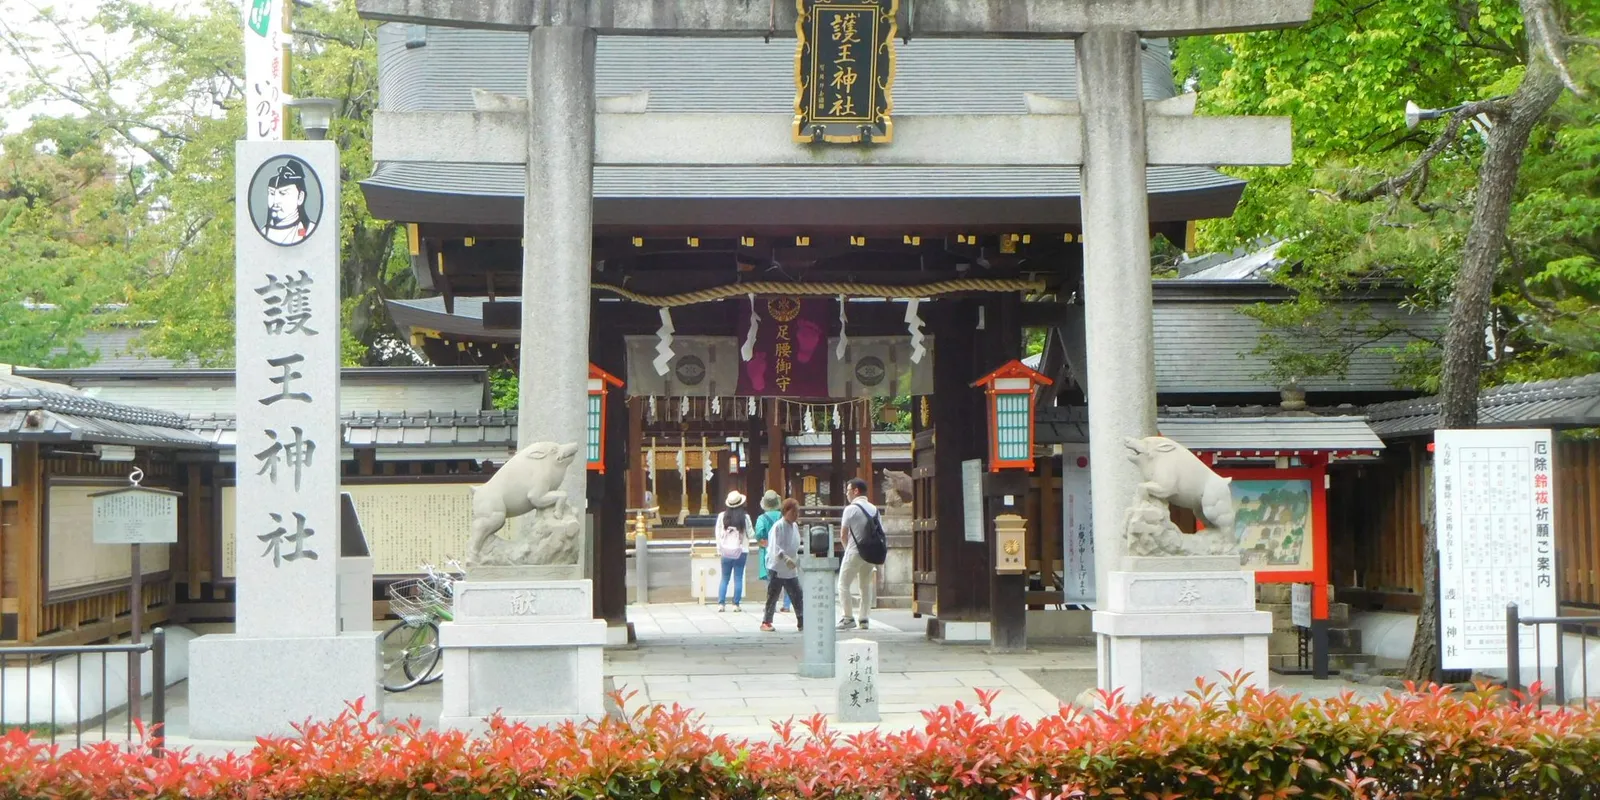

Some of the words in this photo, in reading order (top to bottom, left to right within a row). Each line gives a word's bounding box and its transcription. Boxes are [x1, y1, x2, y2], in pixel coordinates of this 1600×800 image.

[828, 12, 861, 116] 護王神社
[775, 324, 792, 392] 足腰御守
[254, 269, 319, 568] 護王神社
[1533, 440, 1550, 588] 厄除鈴祓祈願ご案内
[1444, 588, 1458, 657] 護王神社
